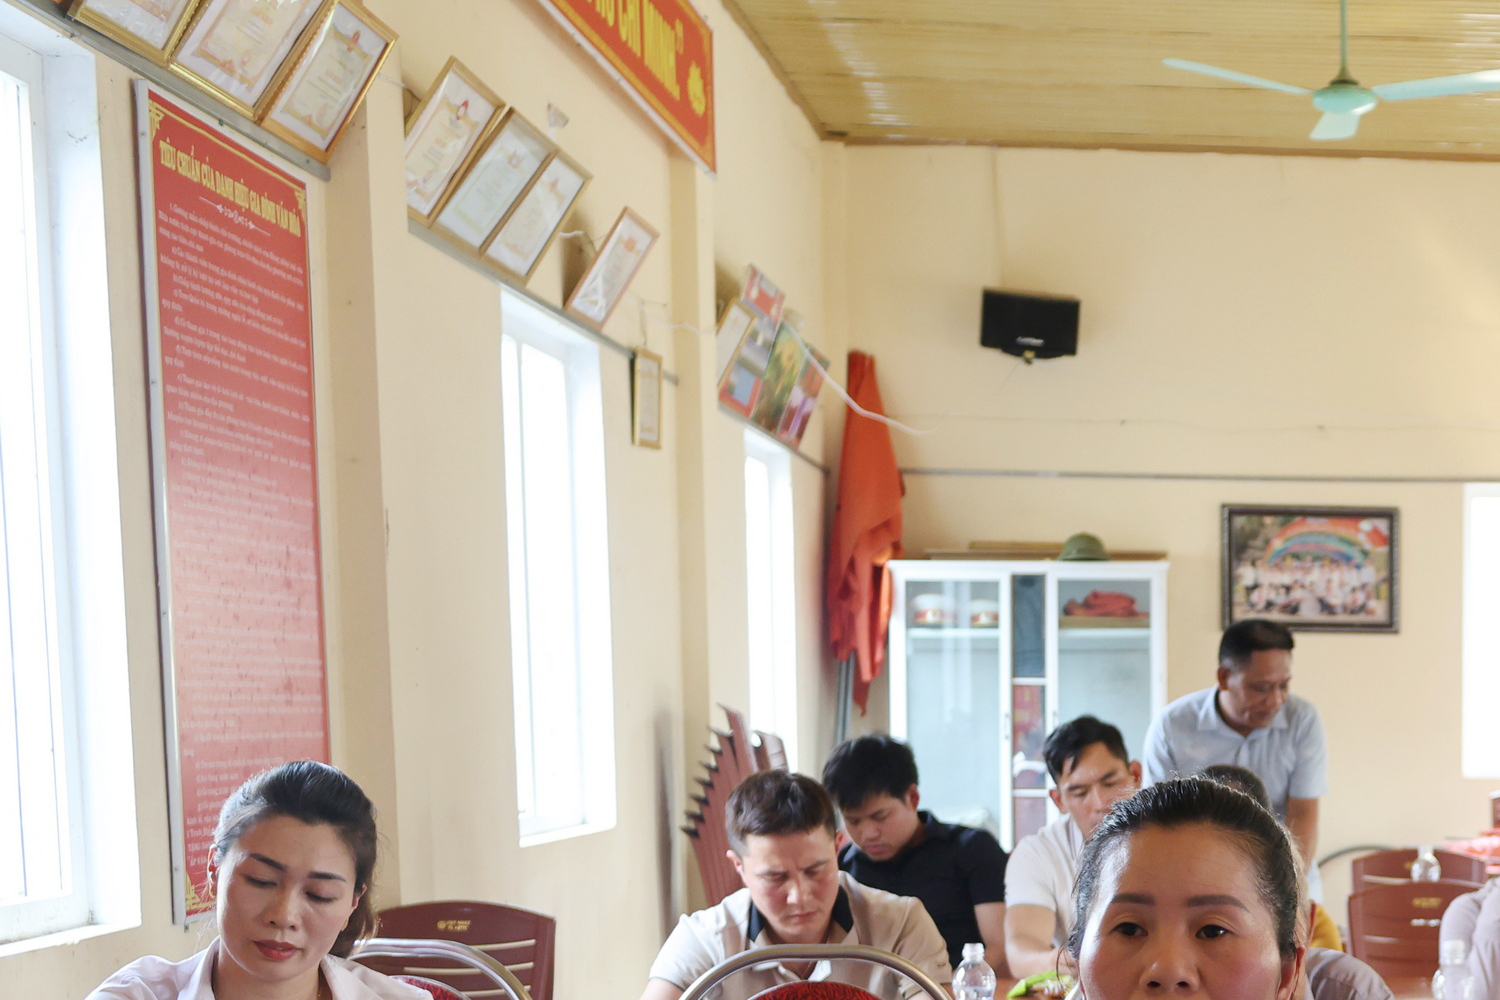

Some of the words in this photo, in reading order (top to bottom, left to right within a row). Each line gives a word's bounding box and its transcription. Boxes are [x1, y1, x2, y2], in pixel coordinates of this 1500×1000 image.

[159, 136, 177, 171] TIÊU
[177, 145, 201, 183] CHUẨN
[201, 156, 215, 192] CỦA
[215, 170, 234, 201] DANH
[234, 178, 249, 212] HIỆU
[249, 190, 261, 216] GIA
